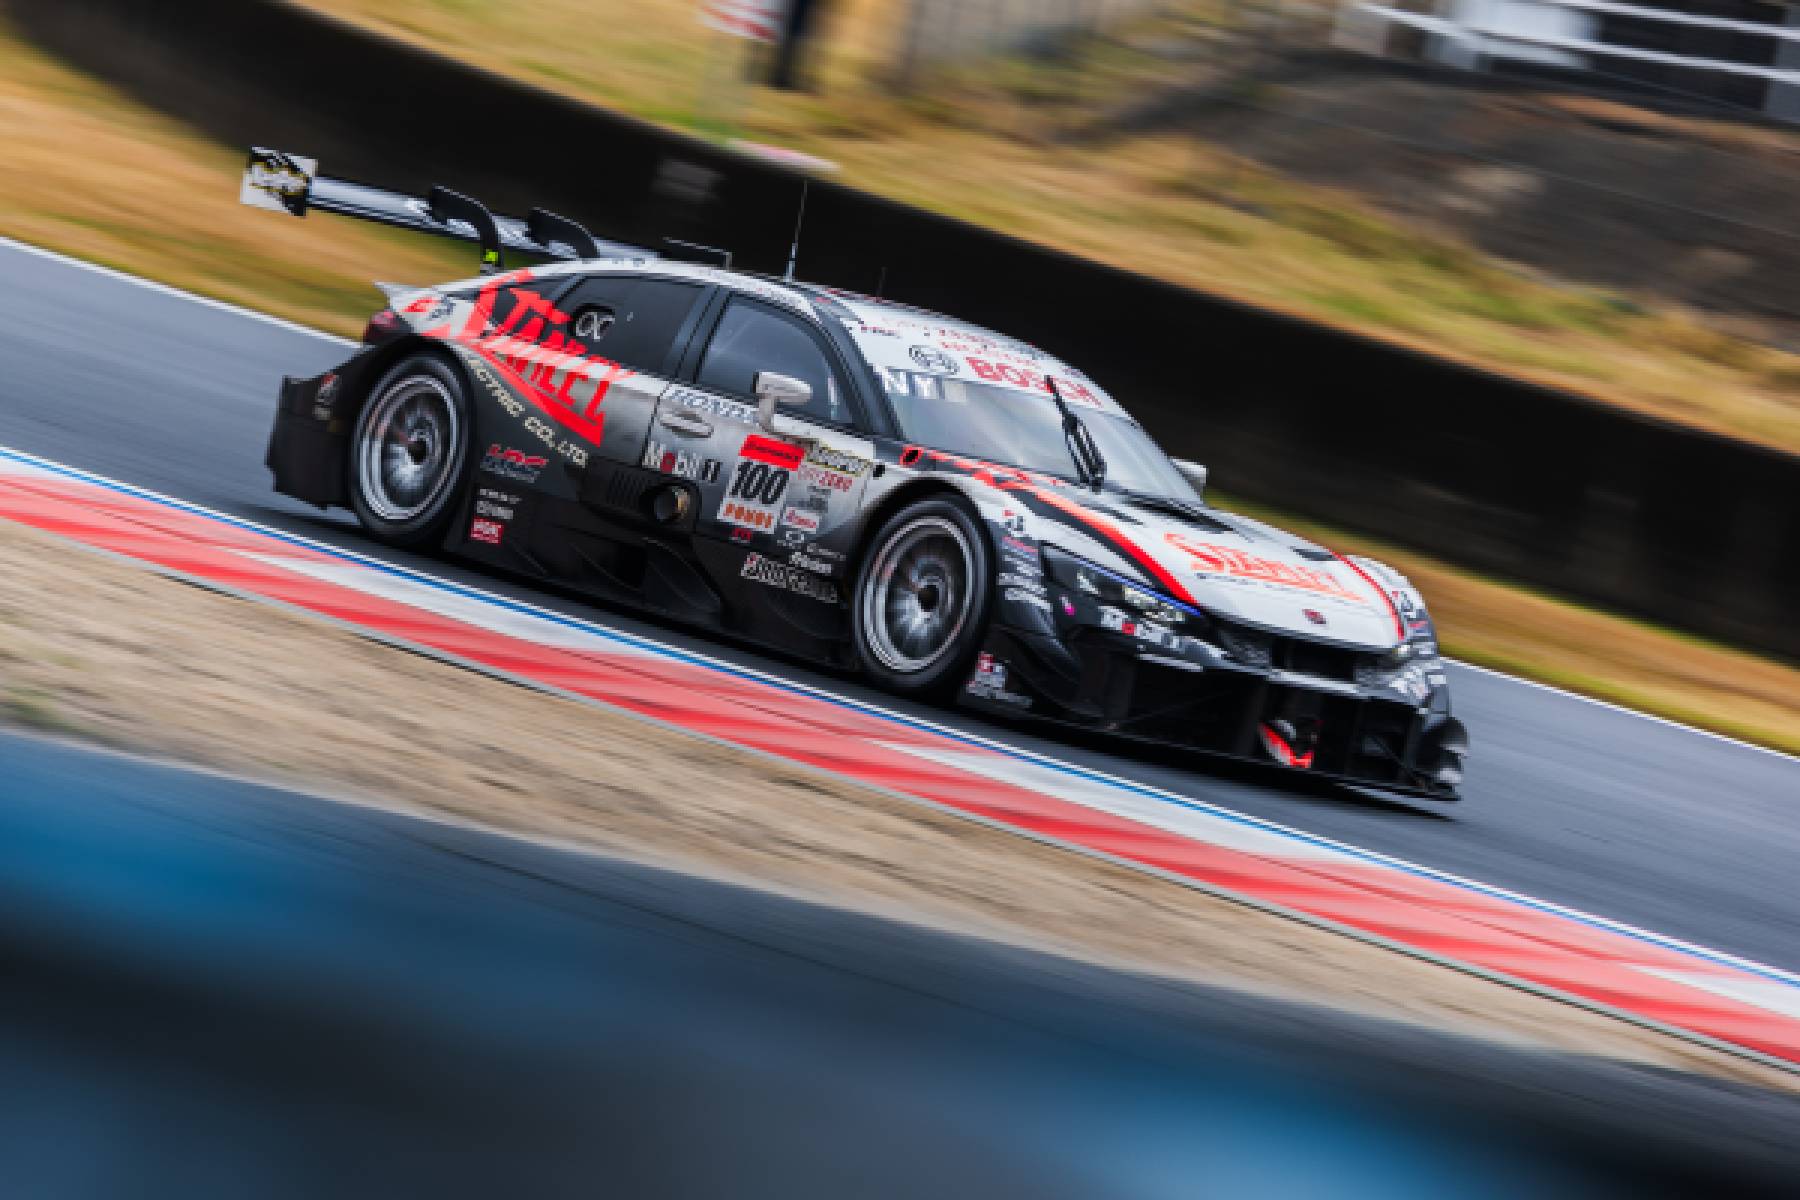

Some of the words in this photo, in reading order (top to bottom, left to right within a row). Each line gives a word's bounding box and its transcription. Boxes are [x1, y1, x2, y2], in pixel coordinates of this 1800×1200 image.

[965, 356, 1102, 408] BOSCH
[641, 440, 700, 478] Mobil
[702, 458, 722, 484] 1
[728, 458, 789, 505] 100
